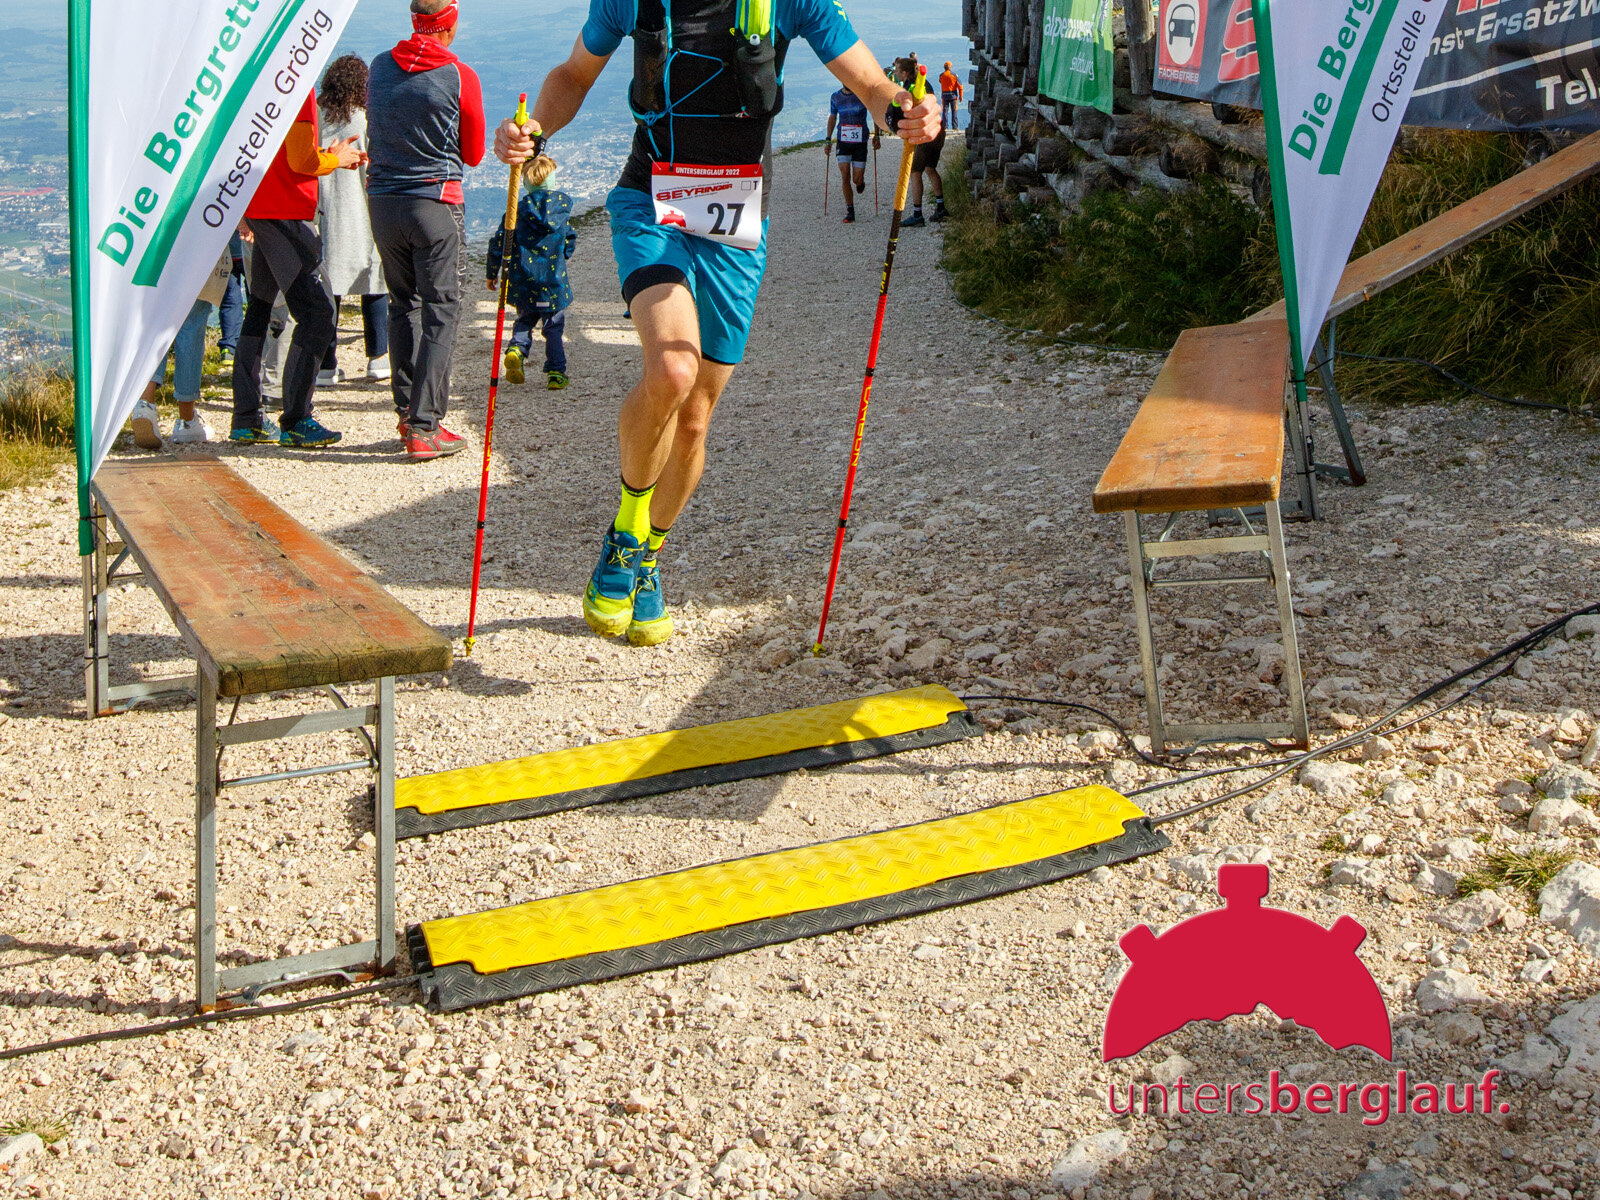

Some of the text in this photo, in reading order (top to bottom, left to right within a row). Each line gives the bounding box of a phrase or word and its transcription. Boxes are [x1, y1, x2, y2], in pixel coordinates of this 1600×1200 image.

[1371, 9, 1426, 123] Ortsstelle
[202, 8, 333, 229] Ortsstelle Grödig
[850, 131, 859, 139] 35
[1288, 92, 1333, 161] Die
[675, 166, 740, 176] UNTERSBERGLAUF 2022
[752, 181, 759, 190] T
[656, 183, 733, 202] SEYRINGER
[97, 186, 158, 267] Die
[706, 202, 746, 236] 27
